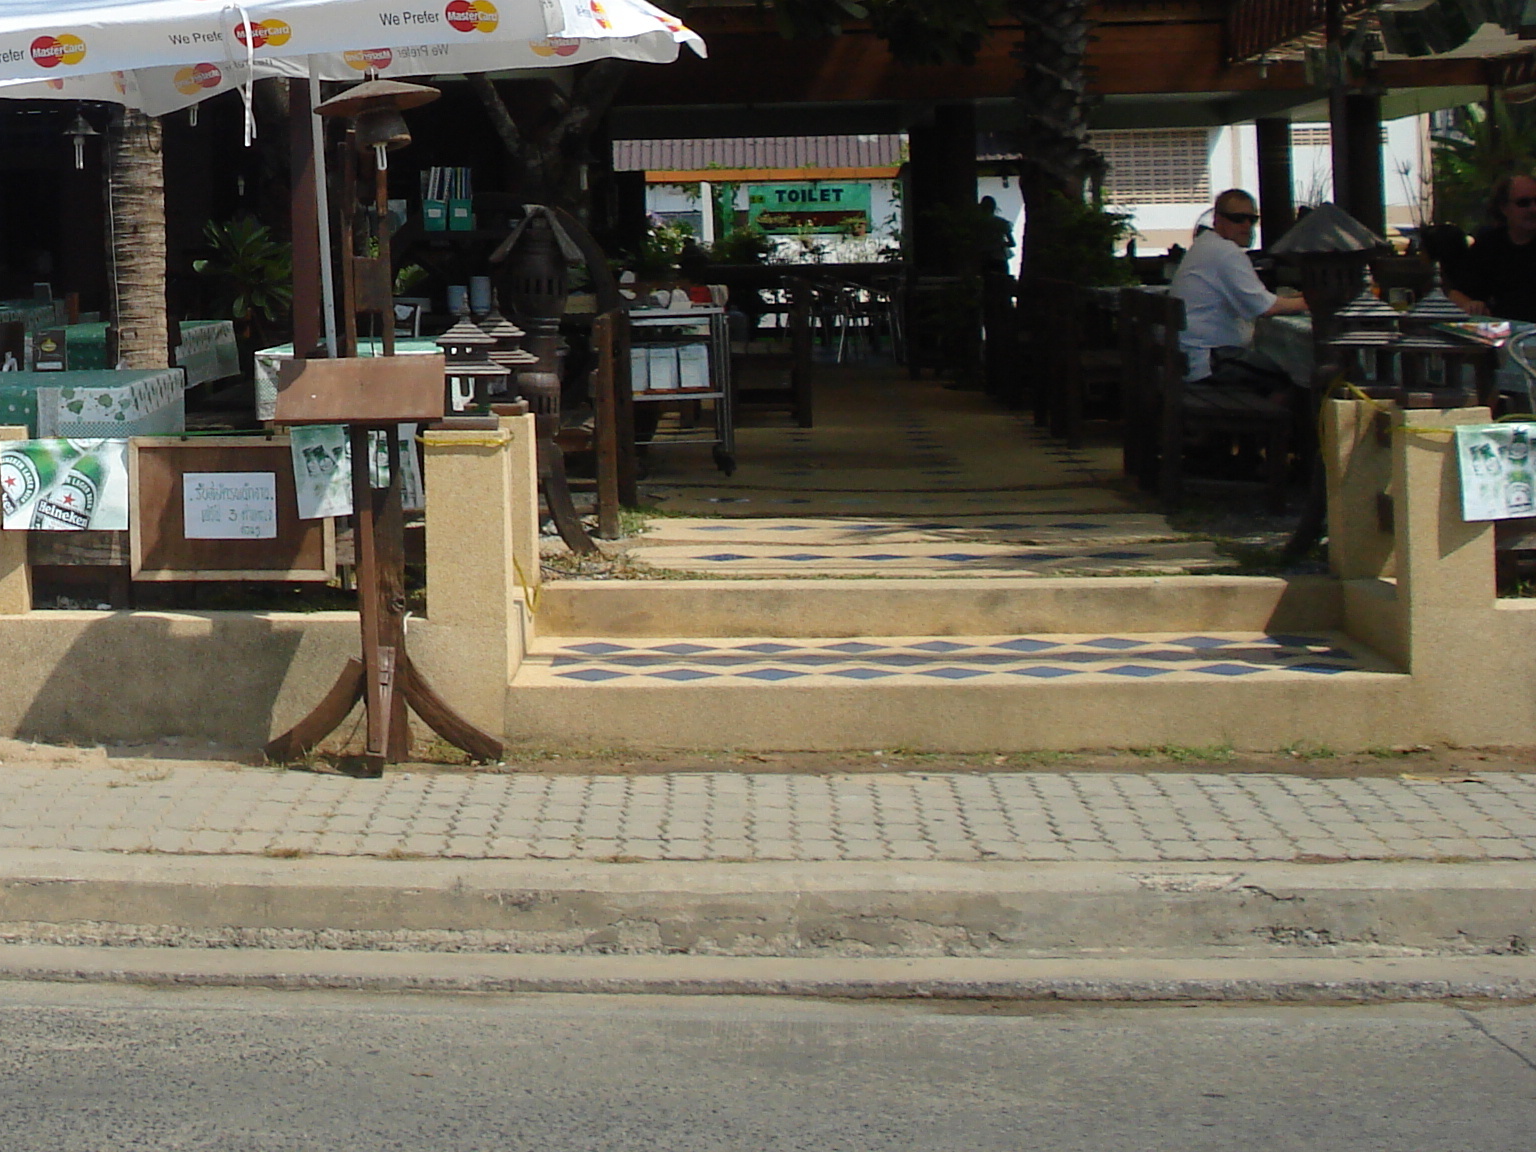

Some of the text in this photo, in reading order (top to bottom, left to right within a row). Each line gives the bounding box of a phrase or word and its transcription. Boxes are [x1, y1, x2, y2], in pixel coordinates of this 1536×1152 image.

[379, 10, 498, 26] We Prefer MasterCard
[168, 34, 190, 46] We
[236, 26, 290, 38] MsterCard
[32, 43, 85, 59] MasterCard
[775, 188, 843, 203] TOILET
